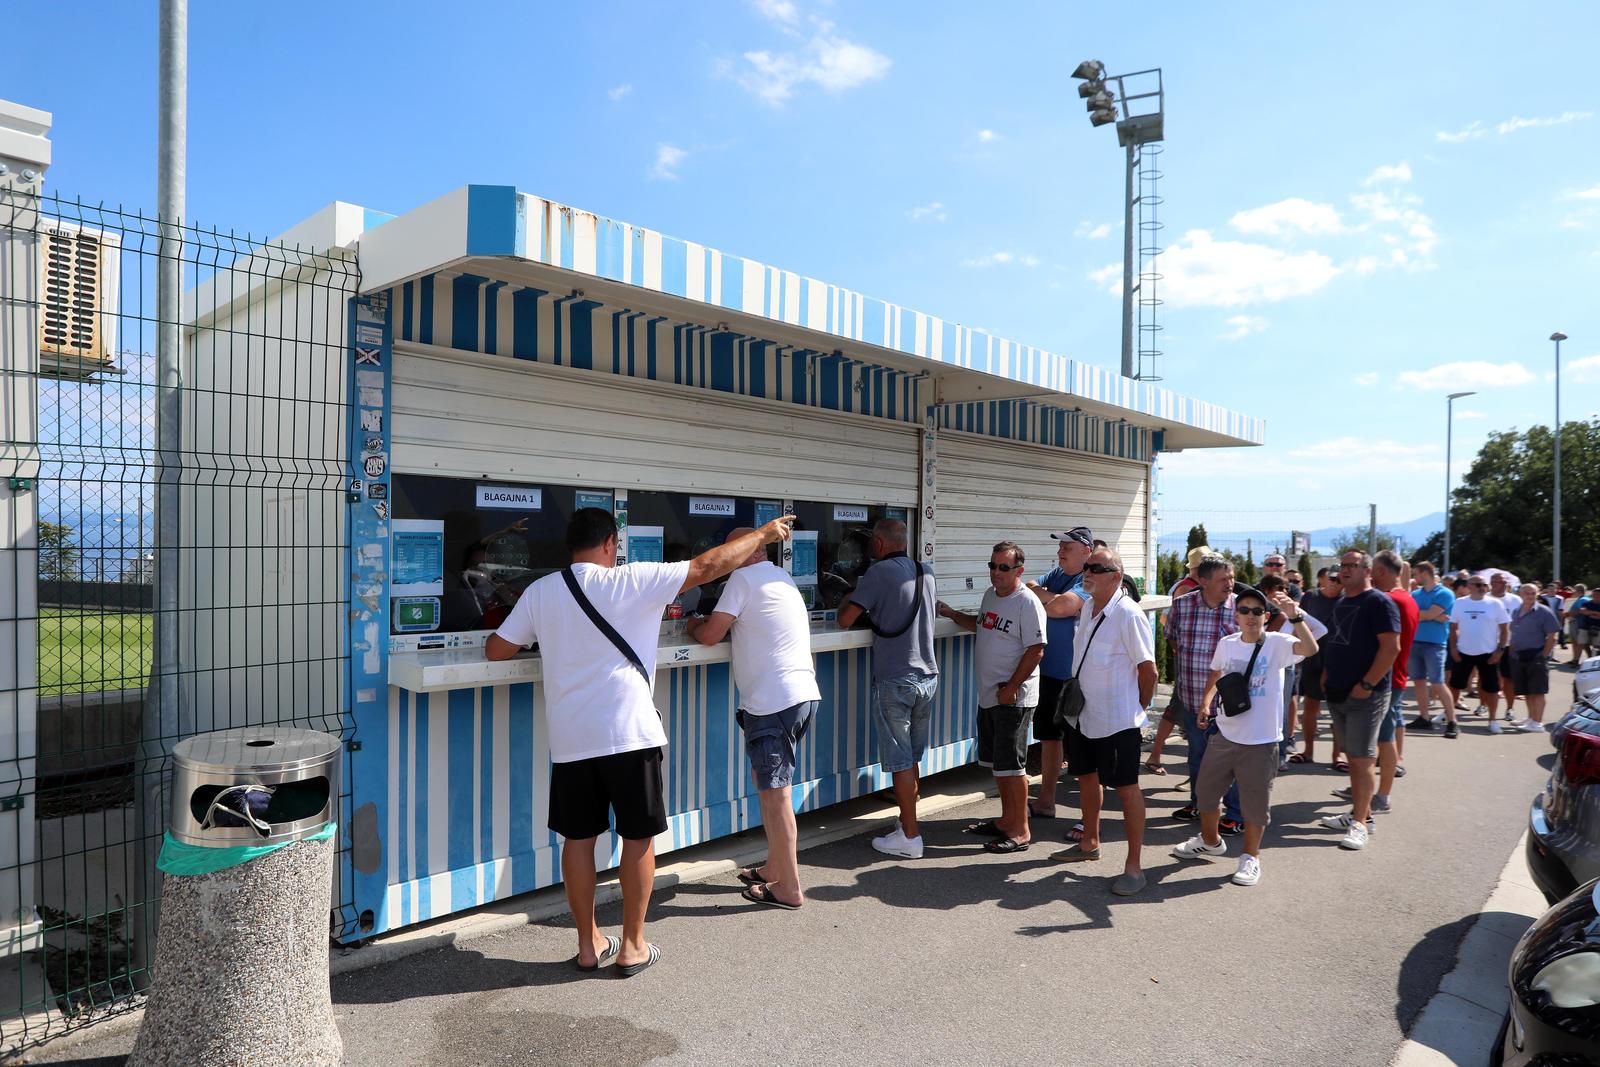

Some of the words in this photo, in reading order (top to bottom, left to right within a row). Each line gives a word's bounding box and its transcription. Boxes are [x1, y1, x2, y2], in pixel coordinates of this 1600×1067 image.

[484, 492, 528, 503] BLAGAJNA
[529, 495, 534, 503] 1
[694, 503, 725, 511] BLAGAJNA
[837, 510, 860, 518] BLAGAJNA
